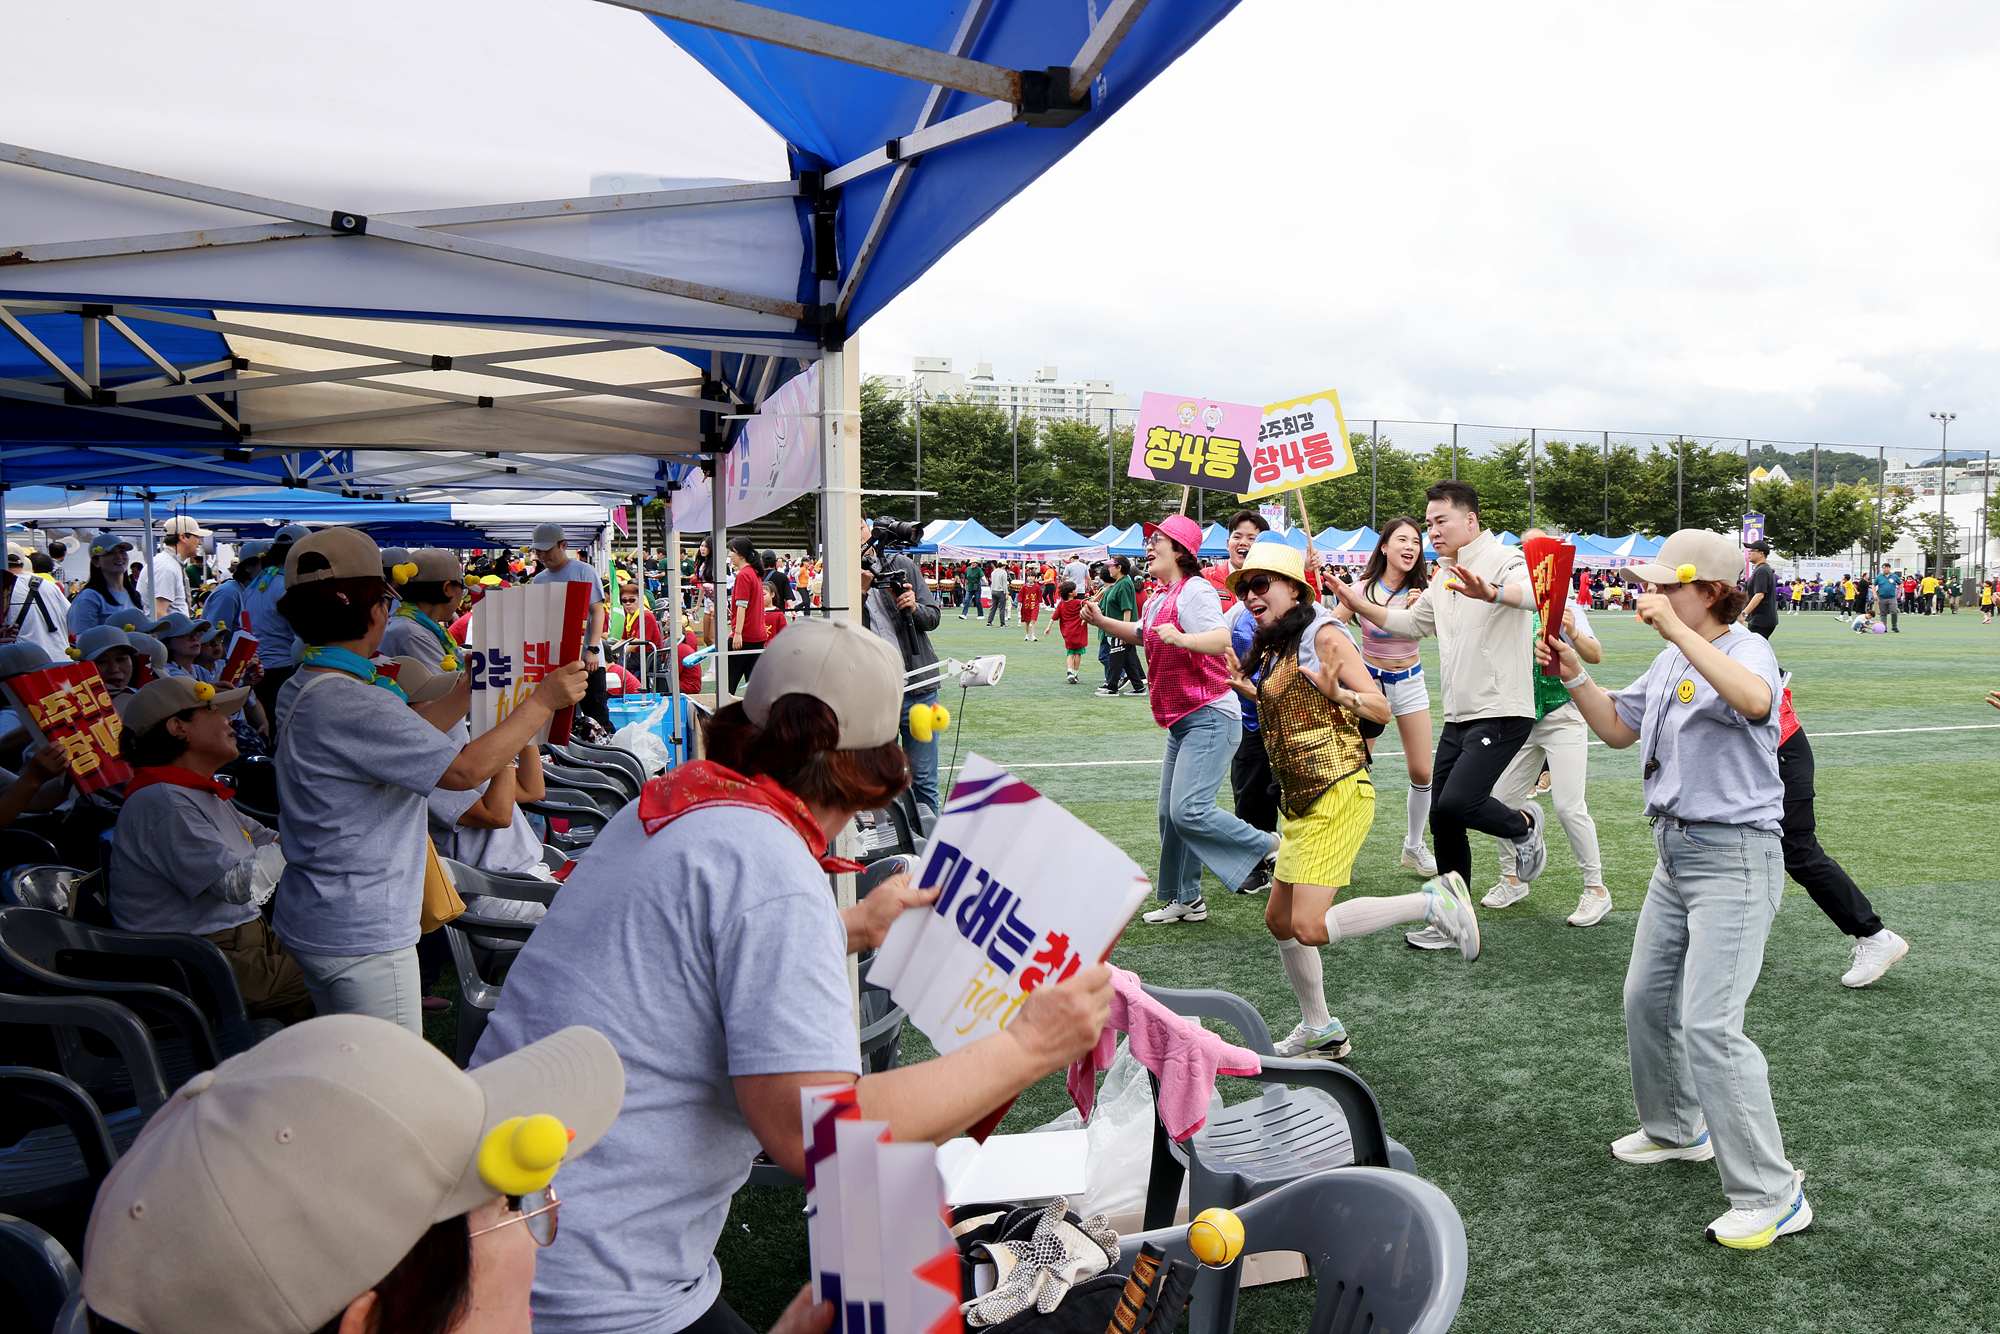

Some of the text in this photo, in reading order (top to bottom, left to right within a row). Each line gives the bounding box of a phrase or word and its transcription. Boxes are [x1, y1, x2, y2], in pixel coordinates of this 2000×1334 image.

[1145, 426, 1241, 480] 창4동
[1252, 432, 1335, 484] 창4동
[1325, 554, 1366, 563] 도봉1동
